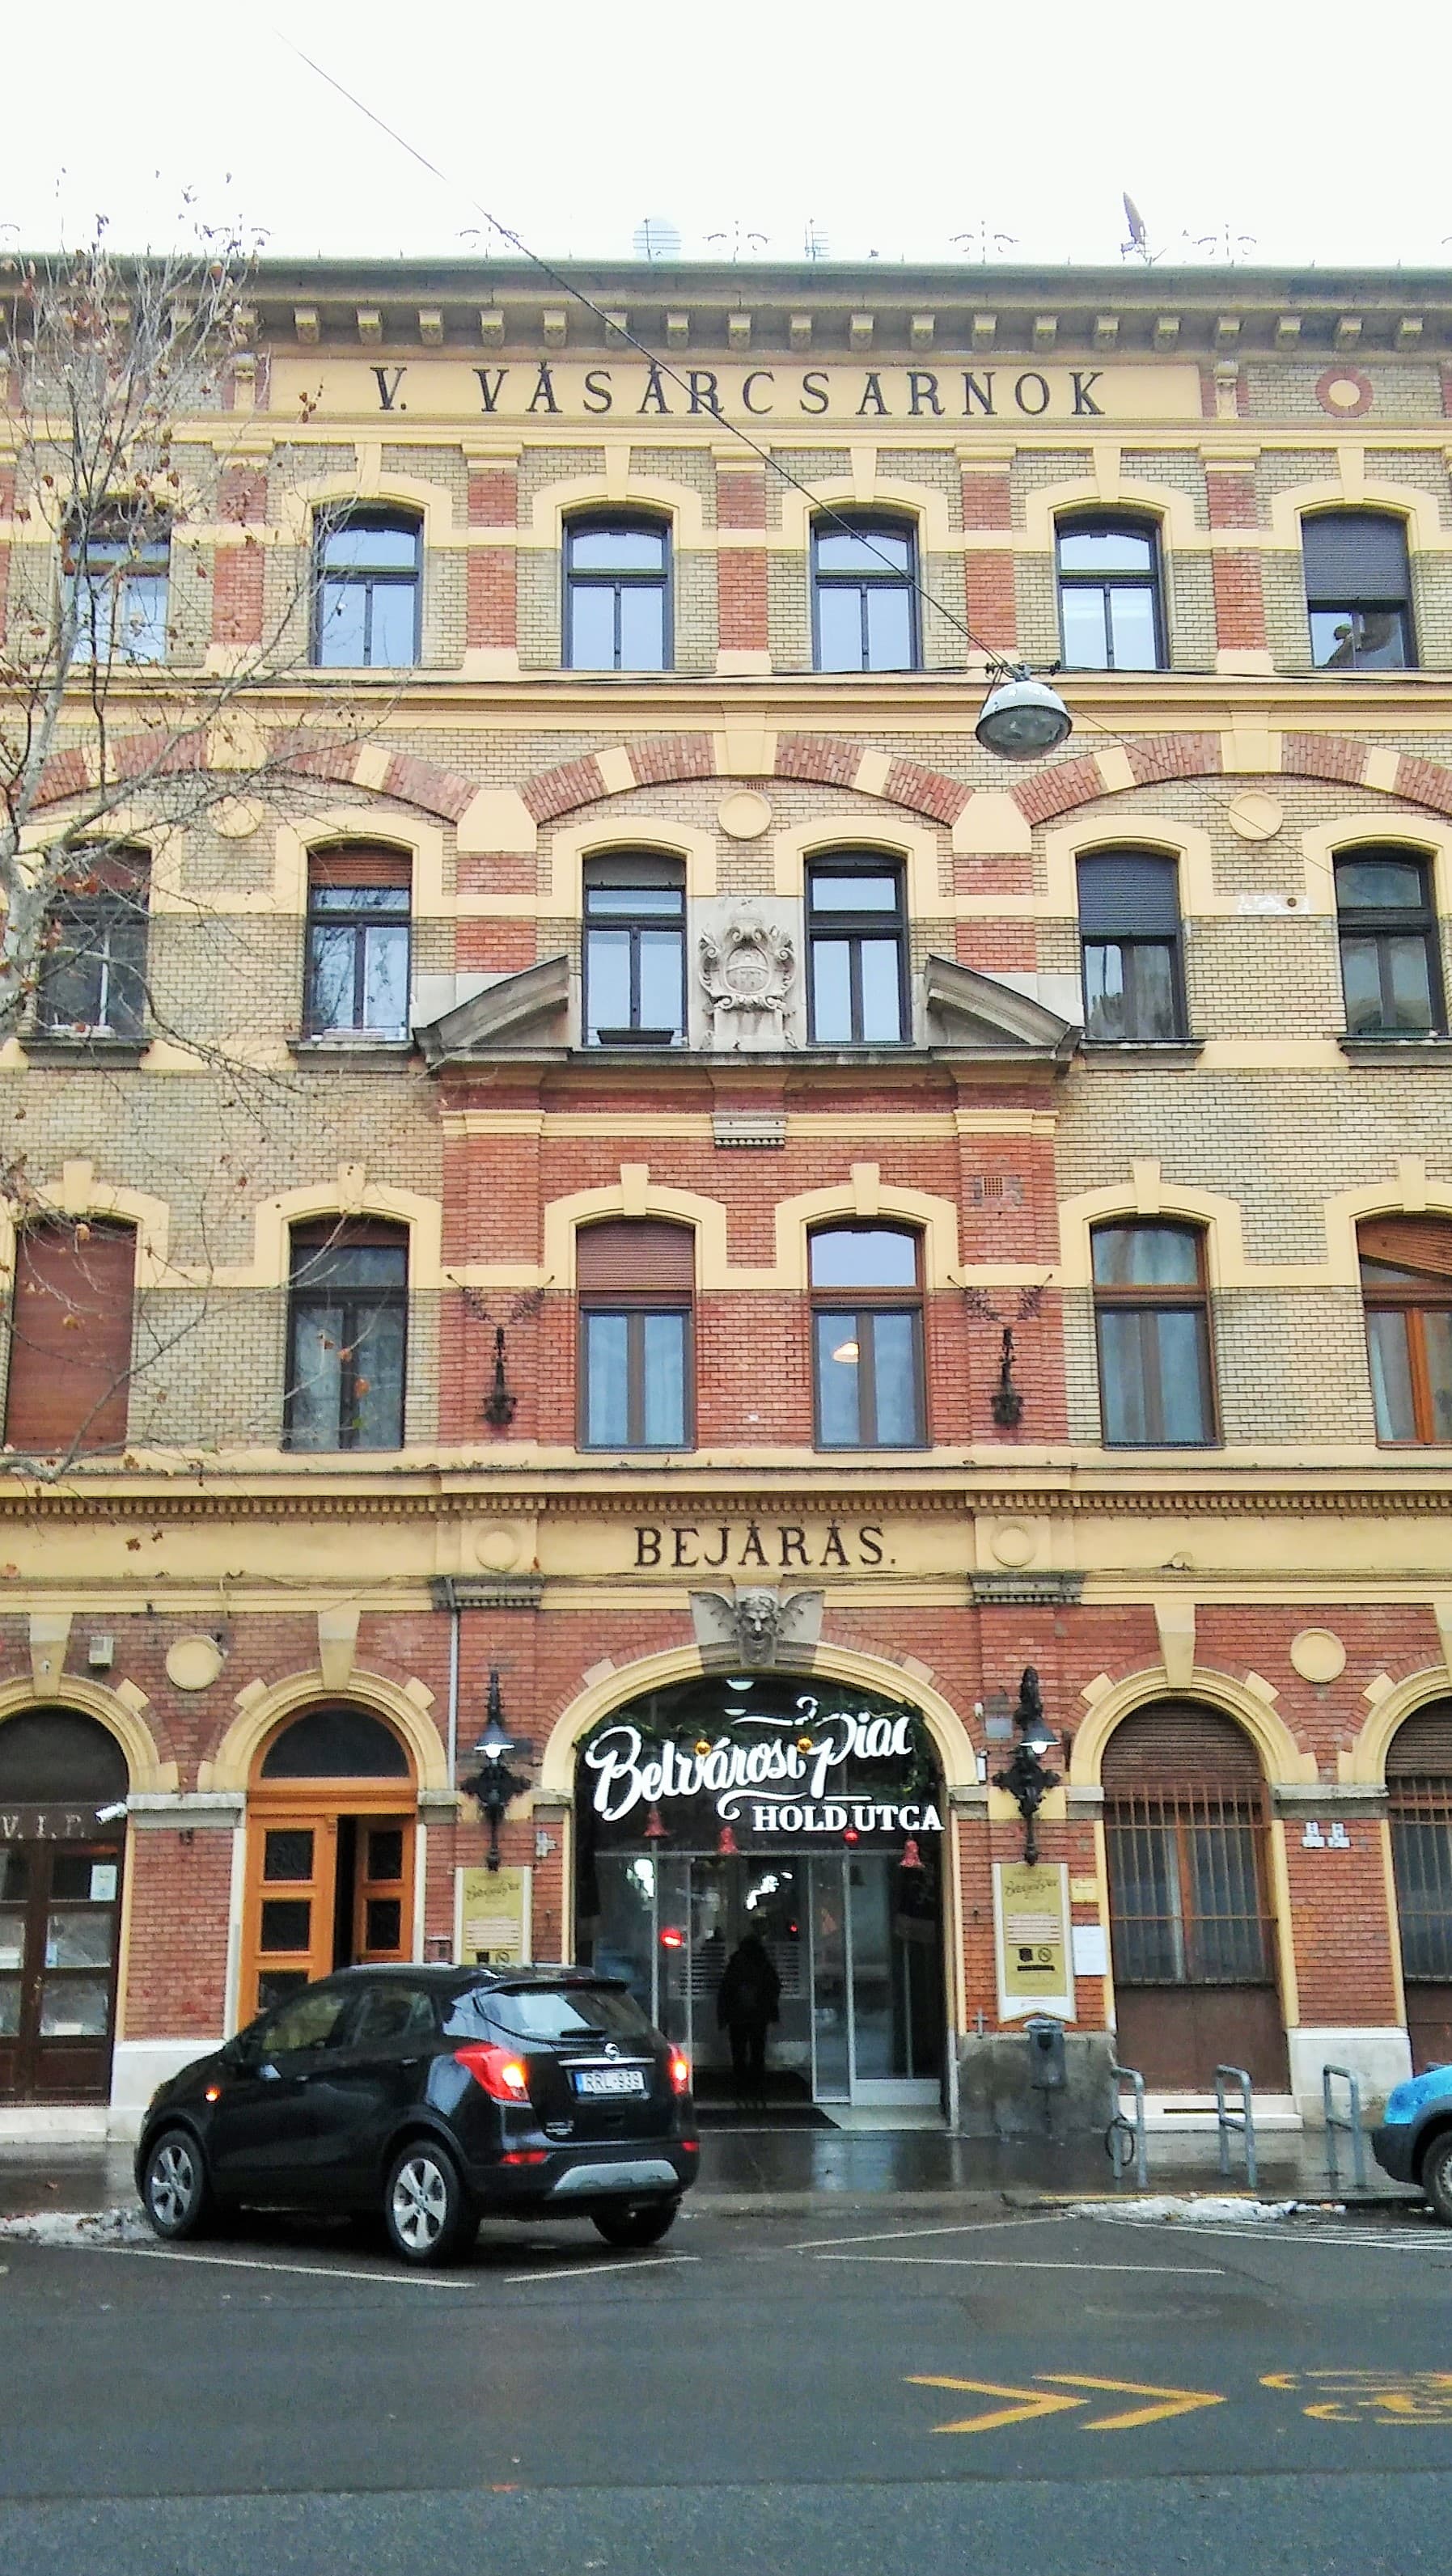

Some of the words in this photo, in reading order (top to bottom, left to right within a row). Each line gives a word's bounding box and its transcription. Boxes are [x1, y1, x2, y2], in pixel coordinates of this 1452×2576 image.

[370, 366, 408, 411] V.
[472, 361, 1106, 415] VÁSÁRCSARNOK
[585, 1725, 807, 1821] Belvárosi
[806, 1712, 913, 1799] Piac
[751, 1805, 848, 1832] HOLD
[851, 1804, 945, 1832] UTCA
